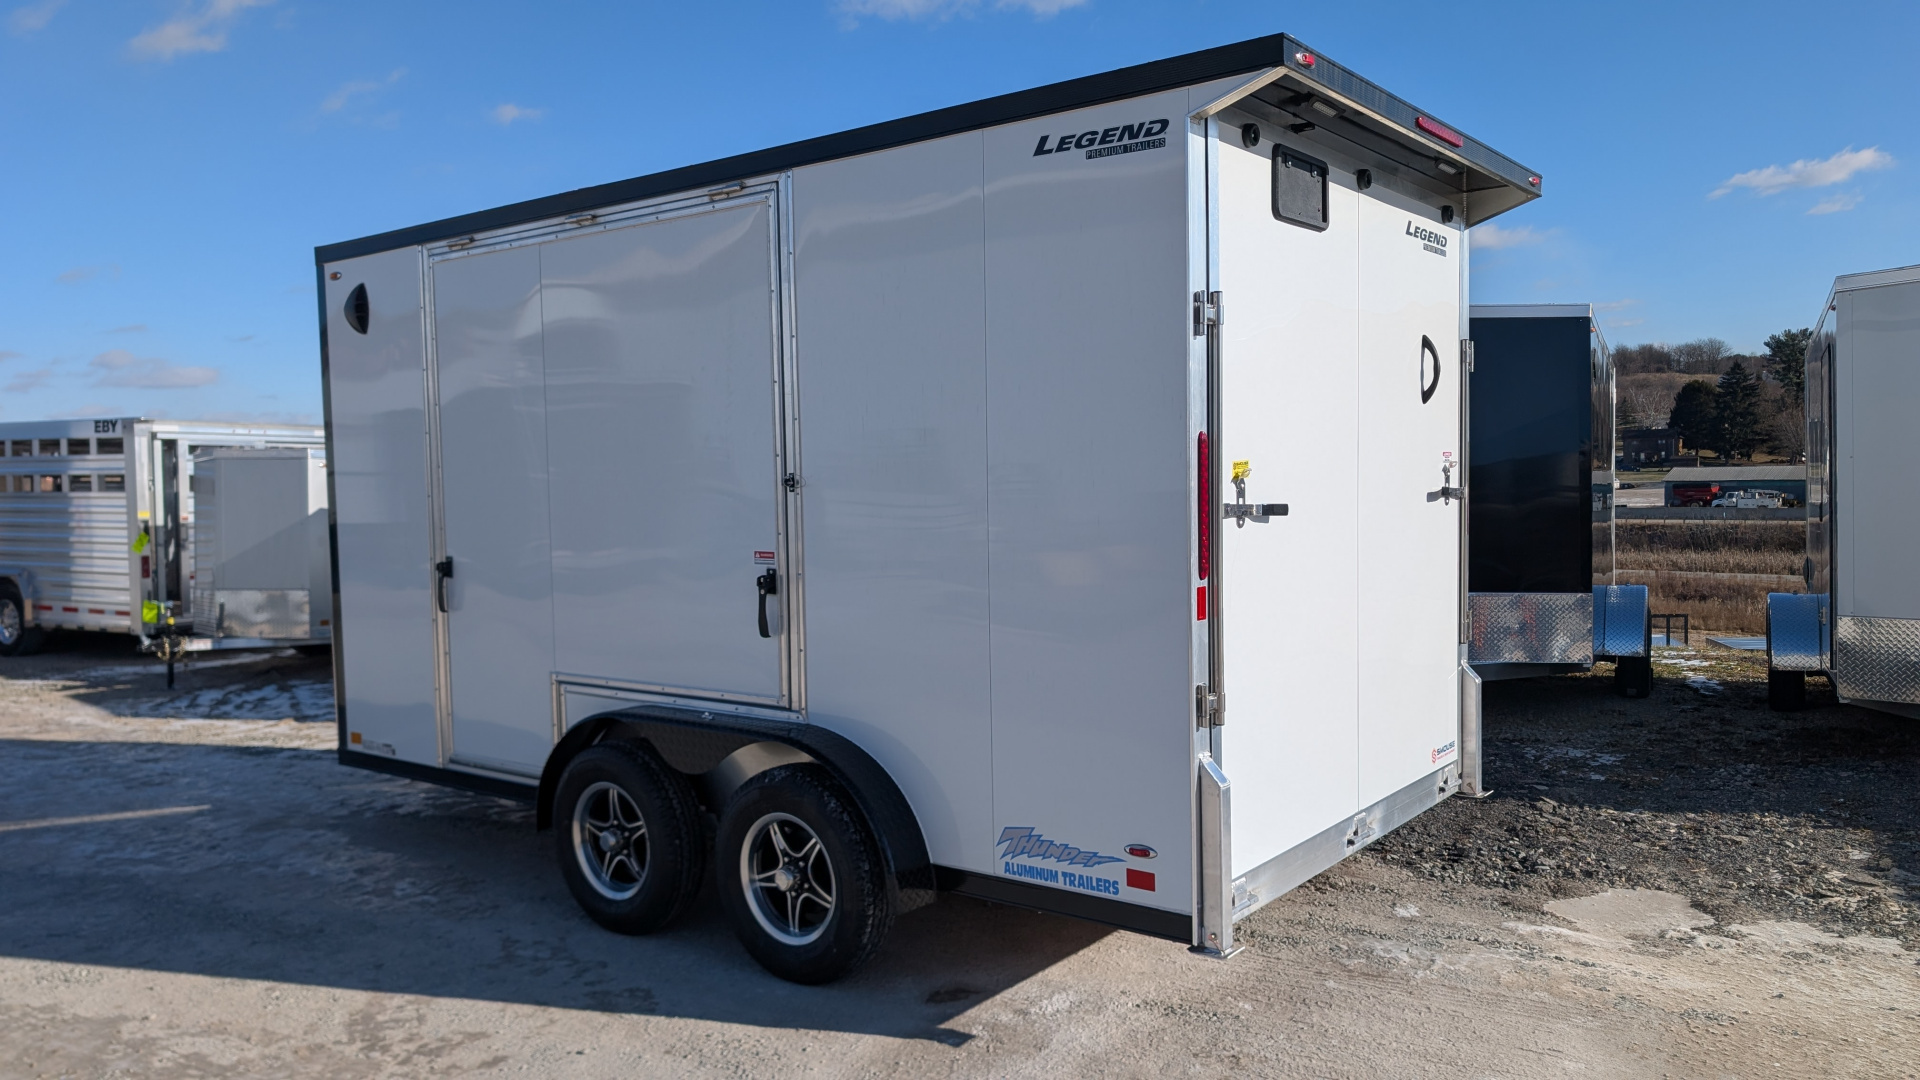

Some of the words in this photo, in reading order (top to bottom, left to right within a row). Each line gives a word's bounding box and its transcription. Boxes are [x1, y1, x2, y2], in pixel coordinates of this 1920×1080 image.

[1033, 118, 1170, 156] LEGEND
[1086, 144, 1124, 159] PREMIUM
[1127, 138, 1165, 152] TRAILERS
[1405, 220, 1447, 247] LEGEND
[94, 420, 118, 433] EBY
[1004, 861, 1059, 884] ALUMINUM
[1061, 871, 1120, 896] TRAILERS
